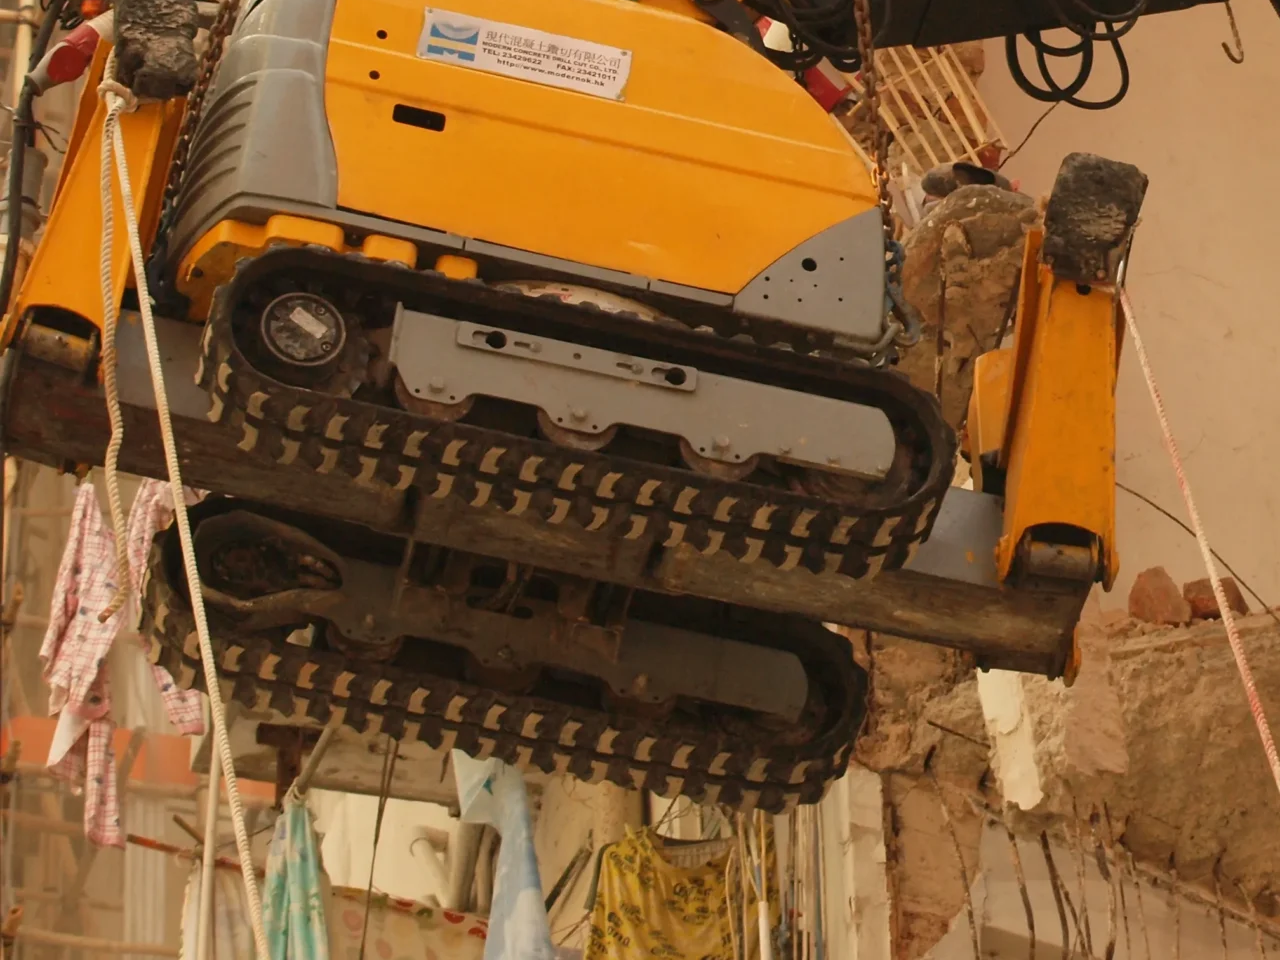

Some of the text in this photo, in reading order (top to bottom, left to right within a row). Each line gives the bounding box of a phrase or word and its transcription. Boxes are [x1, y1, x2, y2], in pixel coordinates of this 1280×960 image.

[482, 41, 512, 51] MODERN
[513, 47, 551, 60] CONCRETE
[552, 56, 572, 65] DRILL
[573, 60, 588, 68] CUT
[482, 47, 617, 81] TEL: 23429622 FAX: 23421011
[496, 58, 605, 87] http://www.modernok.hk
